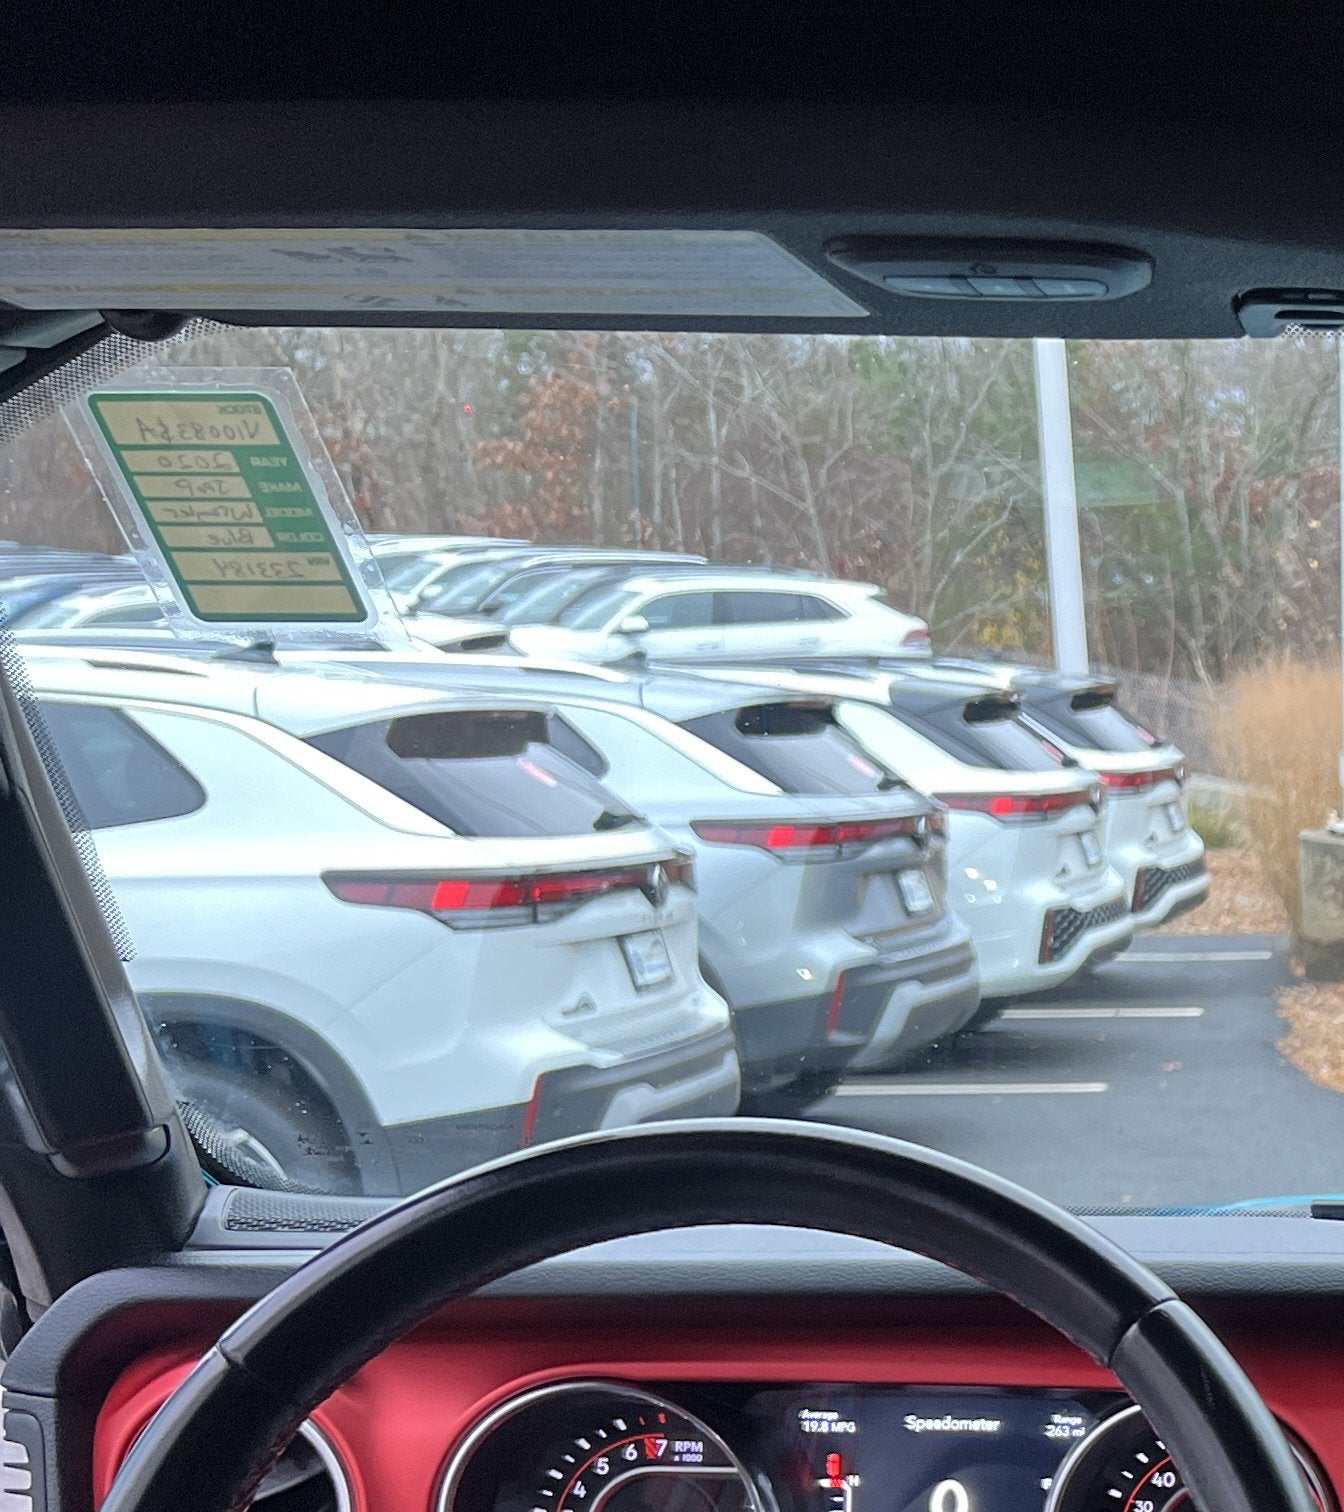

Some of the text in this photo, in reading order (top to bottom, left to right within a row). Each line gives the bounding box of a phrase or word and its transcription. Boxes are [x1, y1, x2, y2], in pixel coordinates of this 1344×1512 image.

[802, 1420, 857, 1433] 19.8 MPG
[903, 1414, 1002, 1433] Speedometer
[1045, 1425, 1069, 1438] 263
[623, 1443, 638, 1461] 6
[655, 1439, 668, 1457] 7
[674, 1440, 704, 1453] RPM
[593, 1457, 610, 1475] 5
[1151, 1472, 1176, 1488] 40
[572, 1481, 587, 1498] 4
